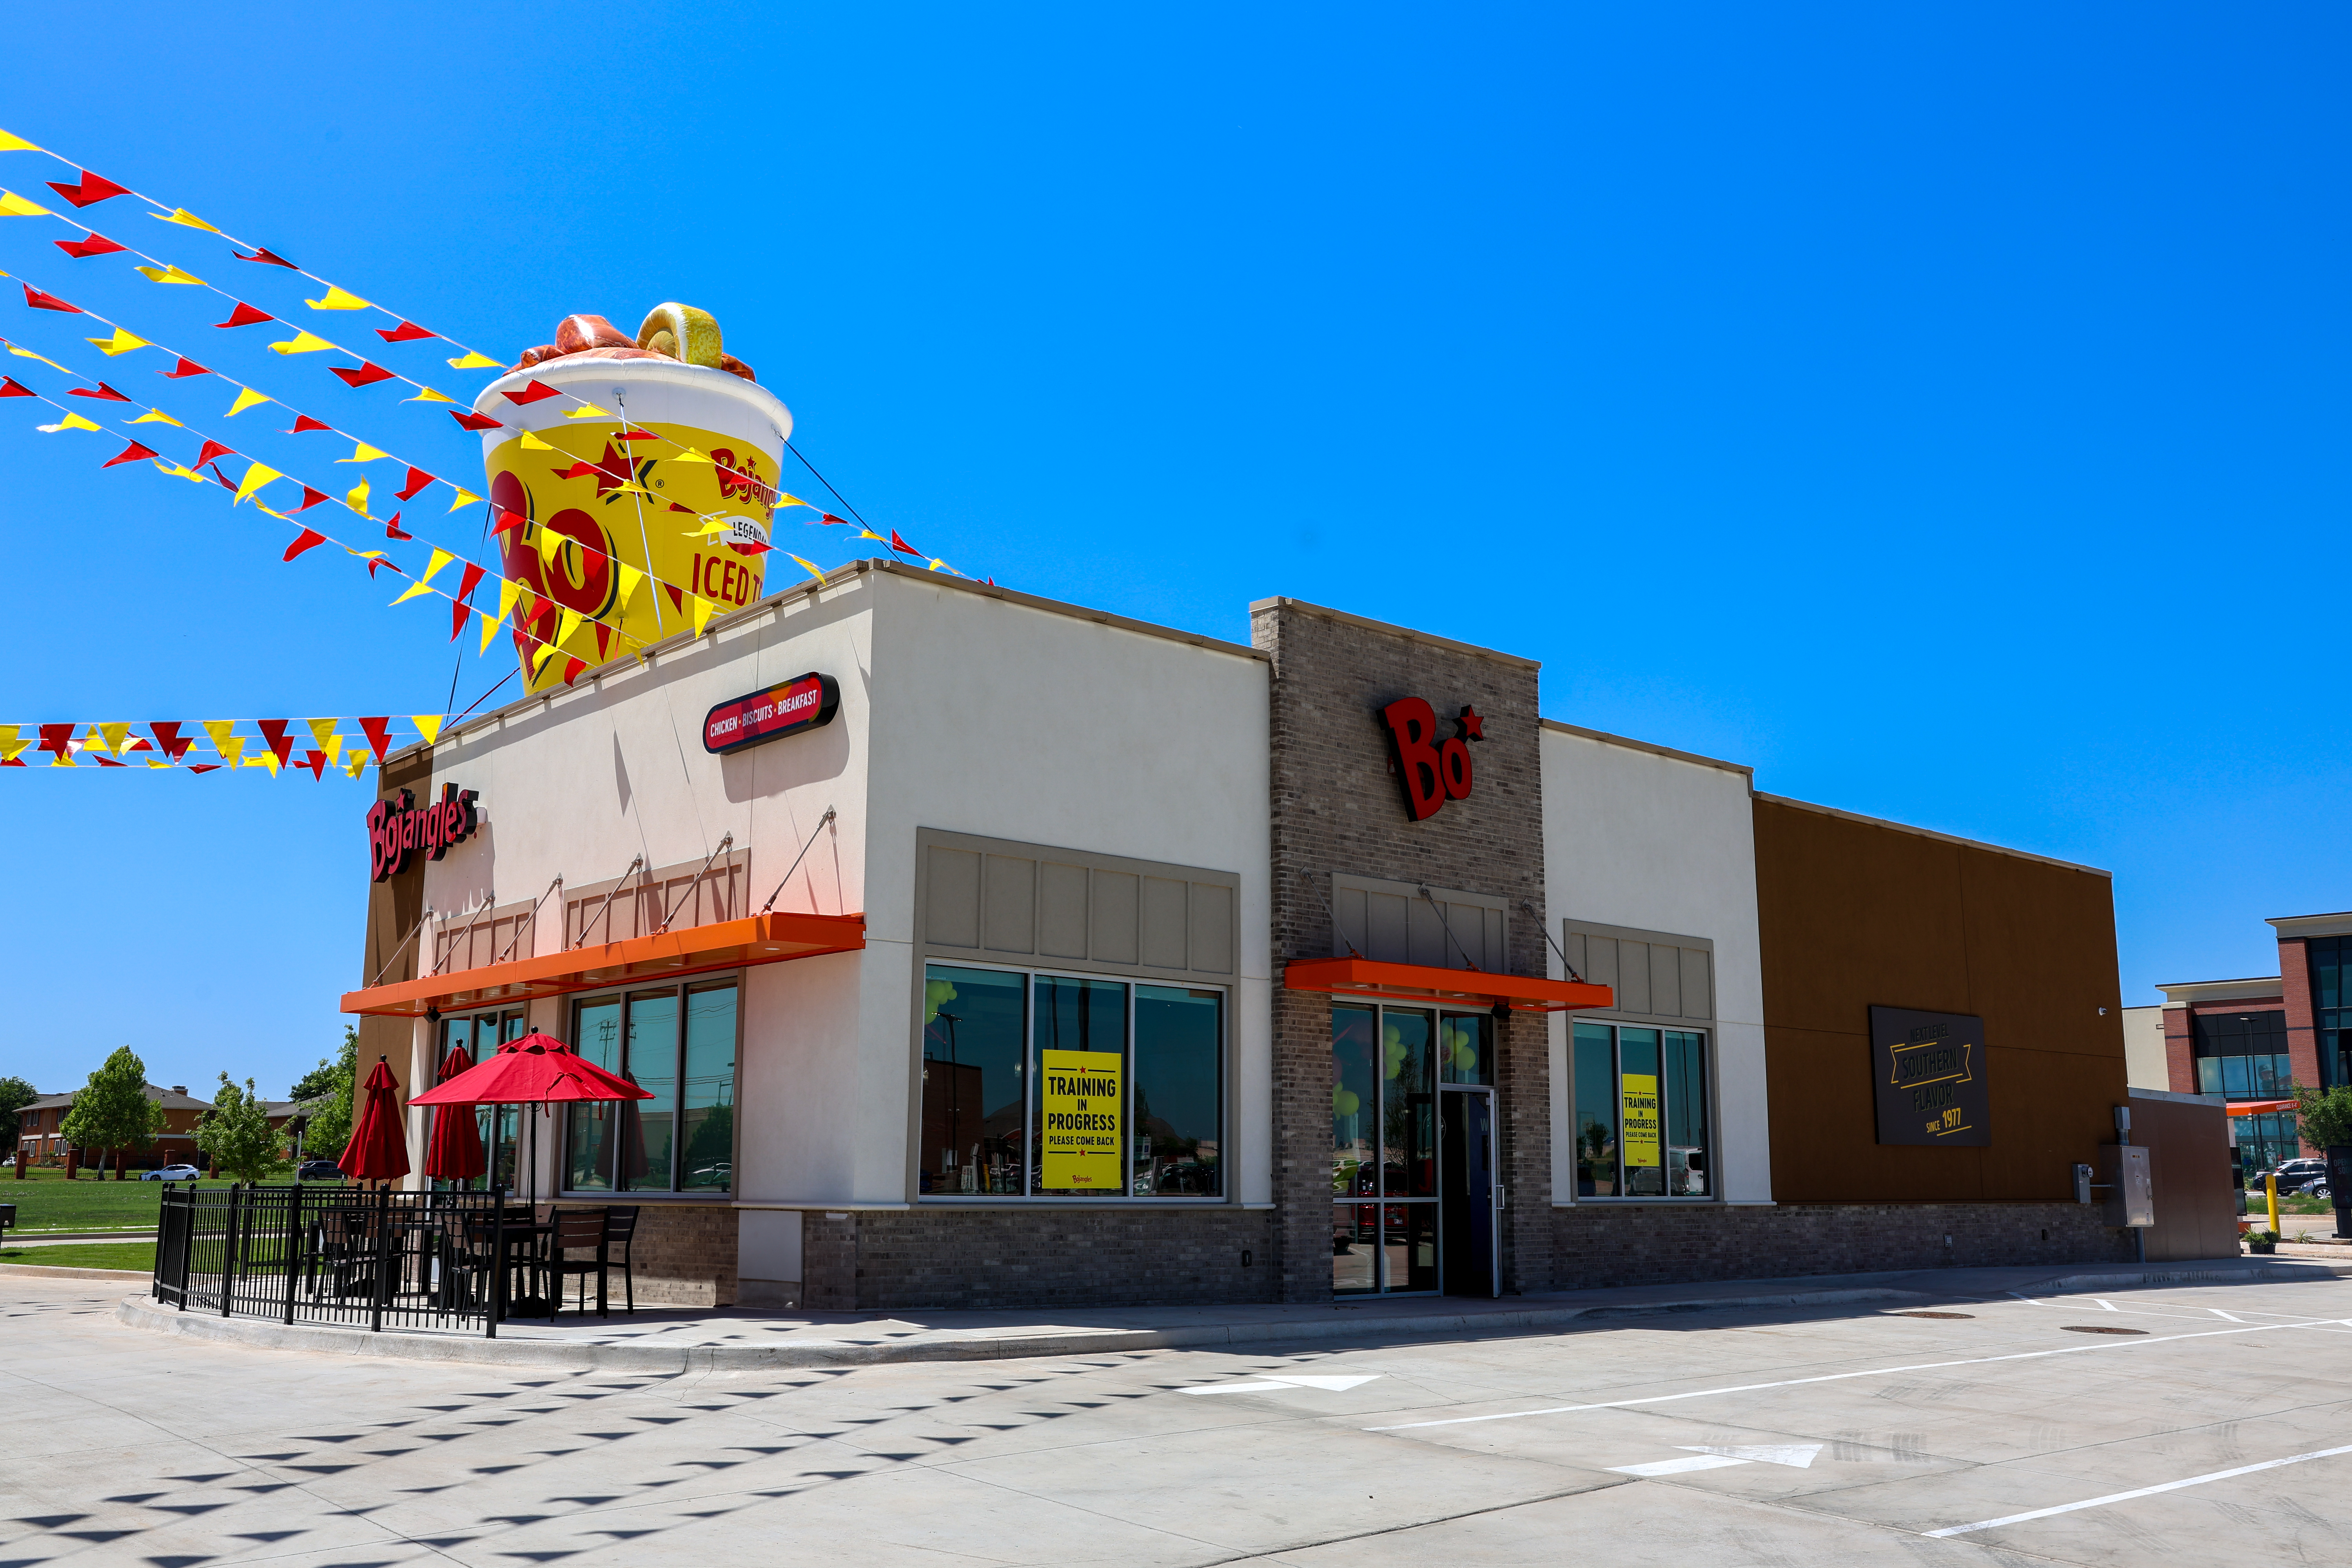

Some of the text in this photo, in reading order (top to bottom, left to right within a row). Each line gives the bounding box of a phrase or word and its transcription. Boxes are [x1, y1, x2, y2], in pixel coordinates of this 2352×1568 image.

[692, 553, 749, 606] ICED
[710, 689, 817, 737] CHICKEN BISCUITS BREAKFAST
[1376, 697, 1473, 822] Bo
[366, 782, 479, 883] Bojangles
[1910, 1023, 1949, 1044] NEXT LEVEL
[1902, 1048, 1958, 1080] SOUTHERN
[1048, 1076, 1116, 1097] TRAINING
[1078, 1099, 1087, 1111] IN
[1624, 1097, 1656, 1109] TRAINING
[1913, 1083, 1954, 1112] FLAVOR
[1048, 1113, 1115, 1131] PROGRESS
[1625, 1118, 1657, 1129] PROGRESS
[1926, 1107, 1960, 1133] SINCE 1977
[1049, 1136, 1114, 1145] PLEASE COME BACK
[1072, 1175, 1092, 1183] Bojangles
